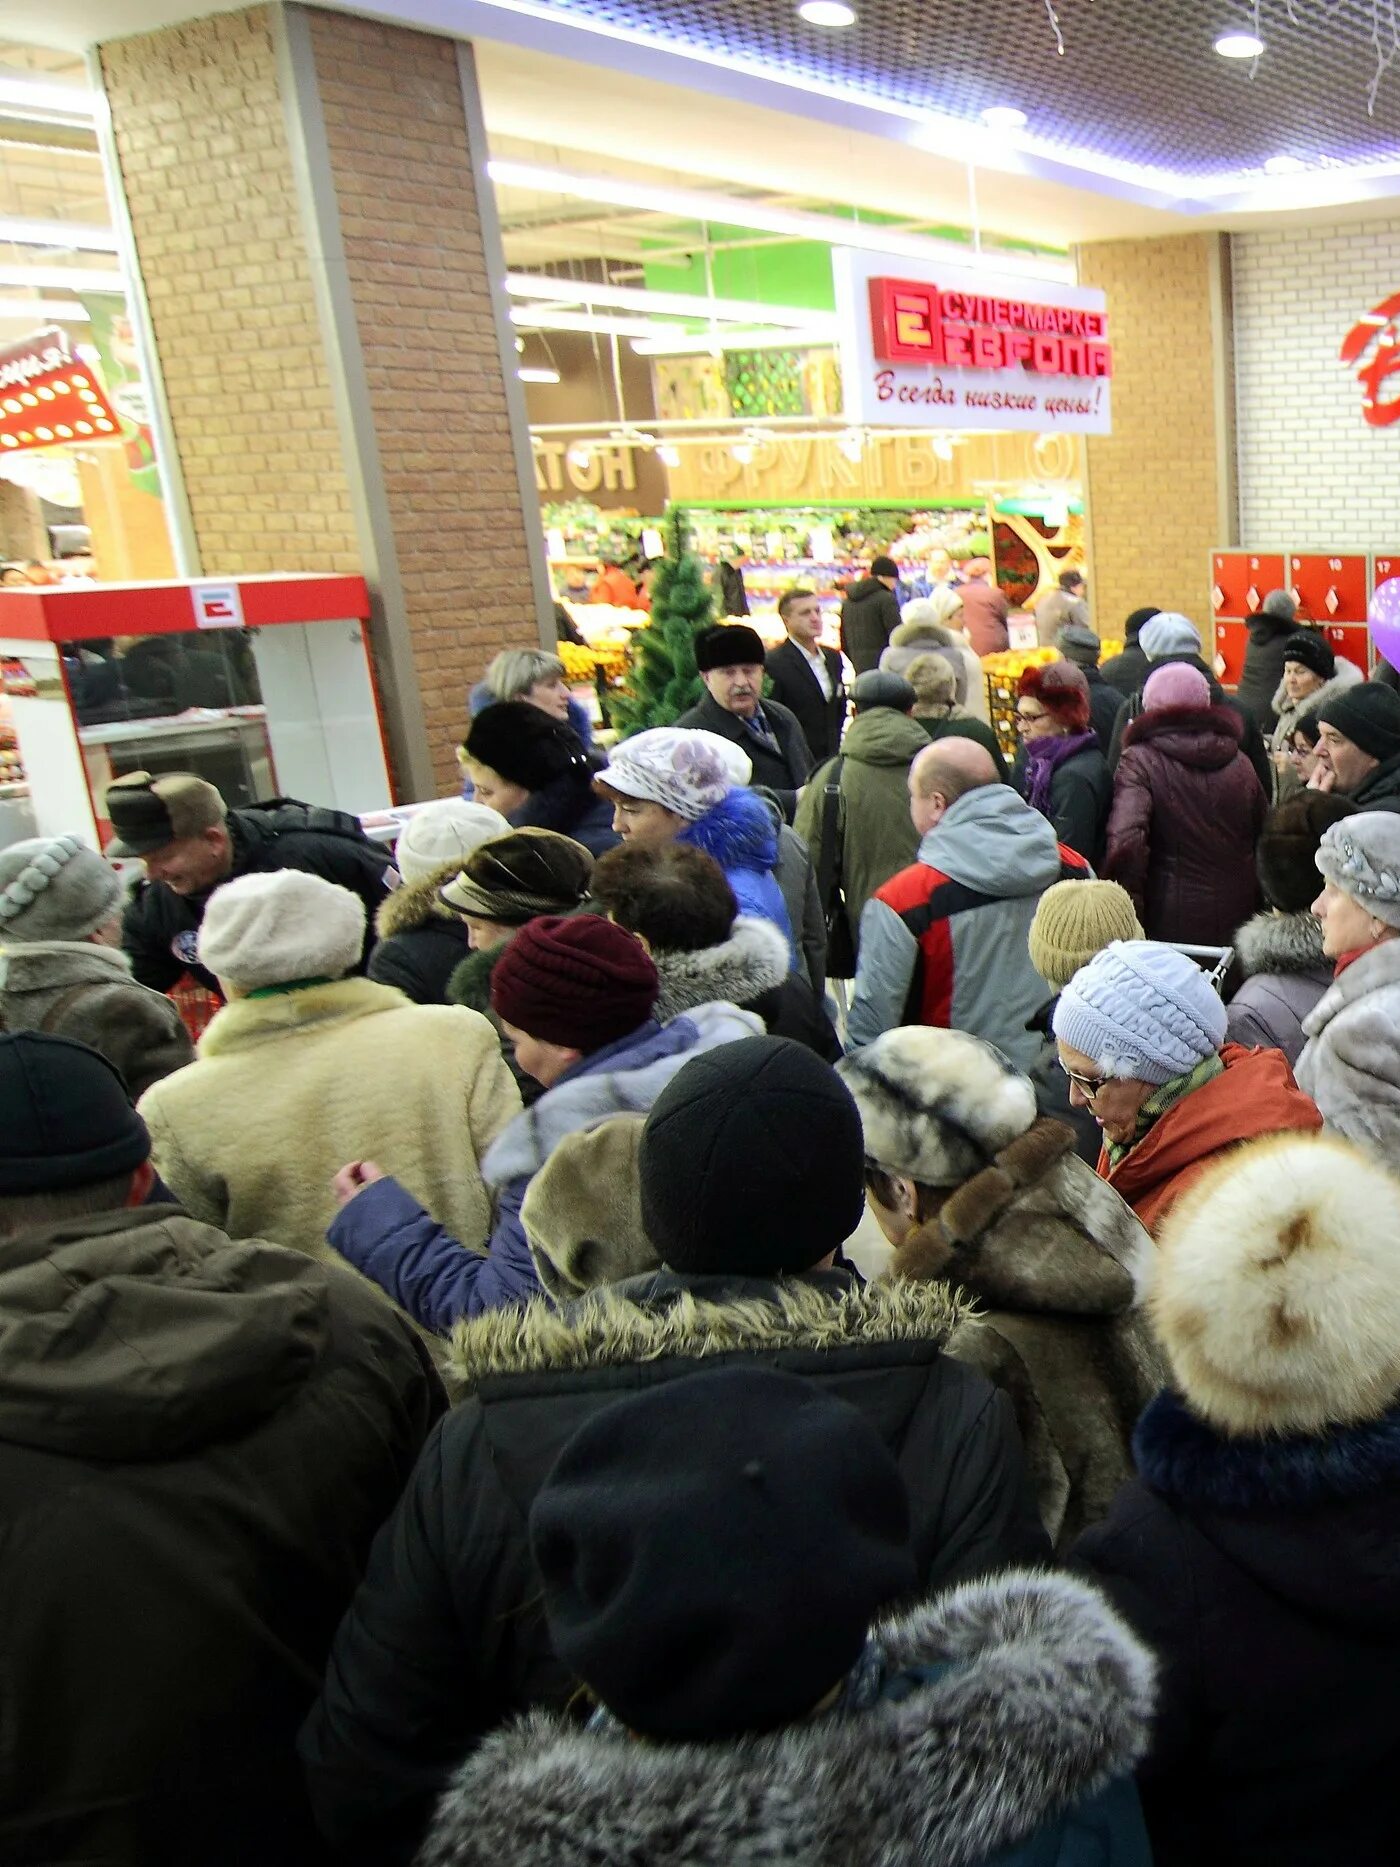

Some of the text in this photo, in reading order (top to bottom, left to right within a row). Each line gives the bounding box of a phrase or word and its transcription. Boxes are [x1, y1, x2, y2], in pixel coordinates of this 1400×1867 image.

[942, 290, 1109, 337] СУПЕРМАРКЕТ
[943, 321, 1113, 378] ЕВРОПА
[874, 370, 1102, 419] Всегда низкие цены!
[1377, 561, 1391, 574] 17
